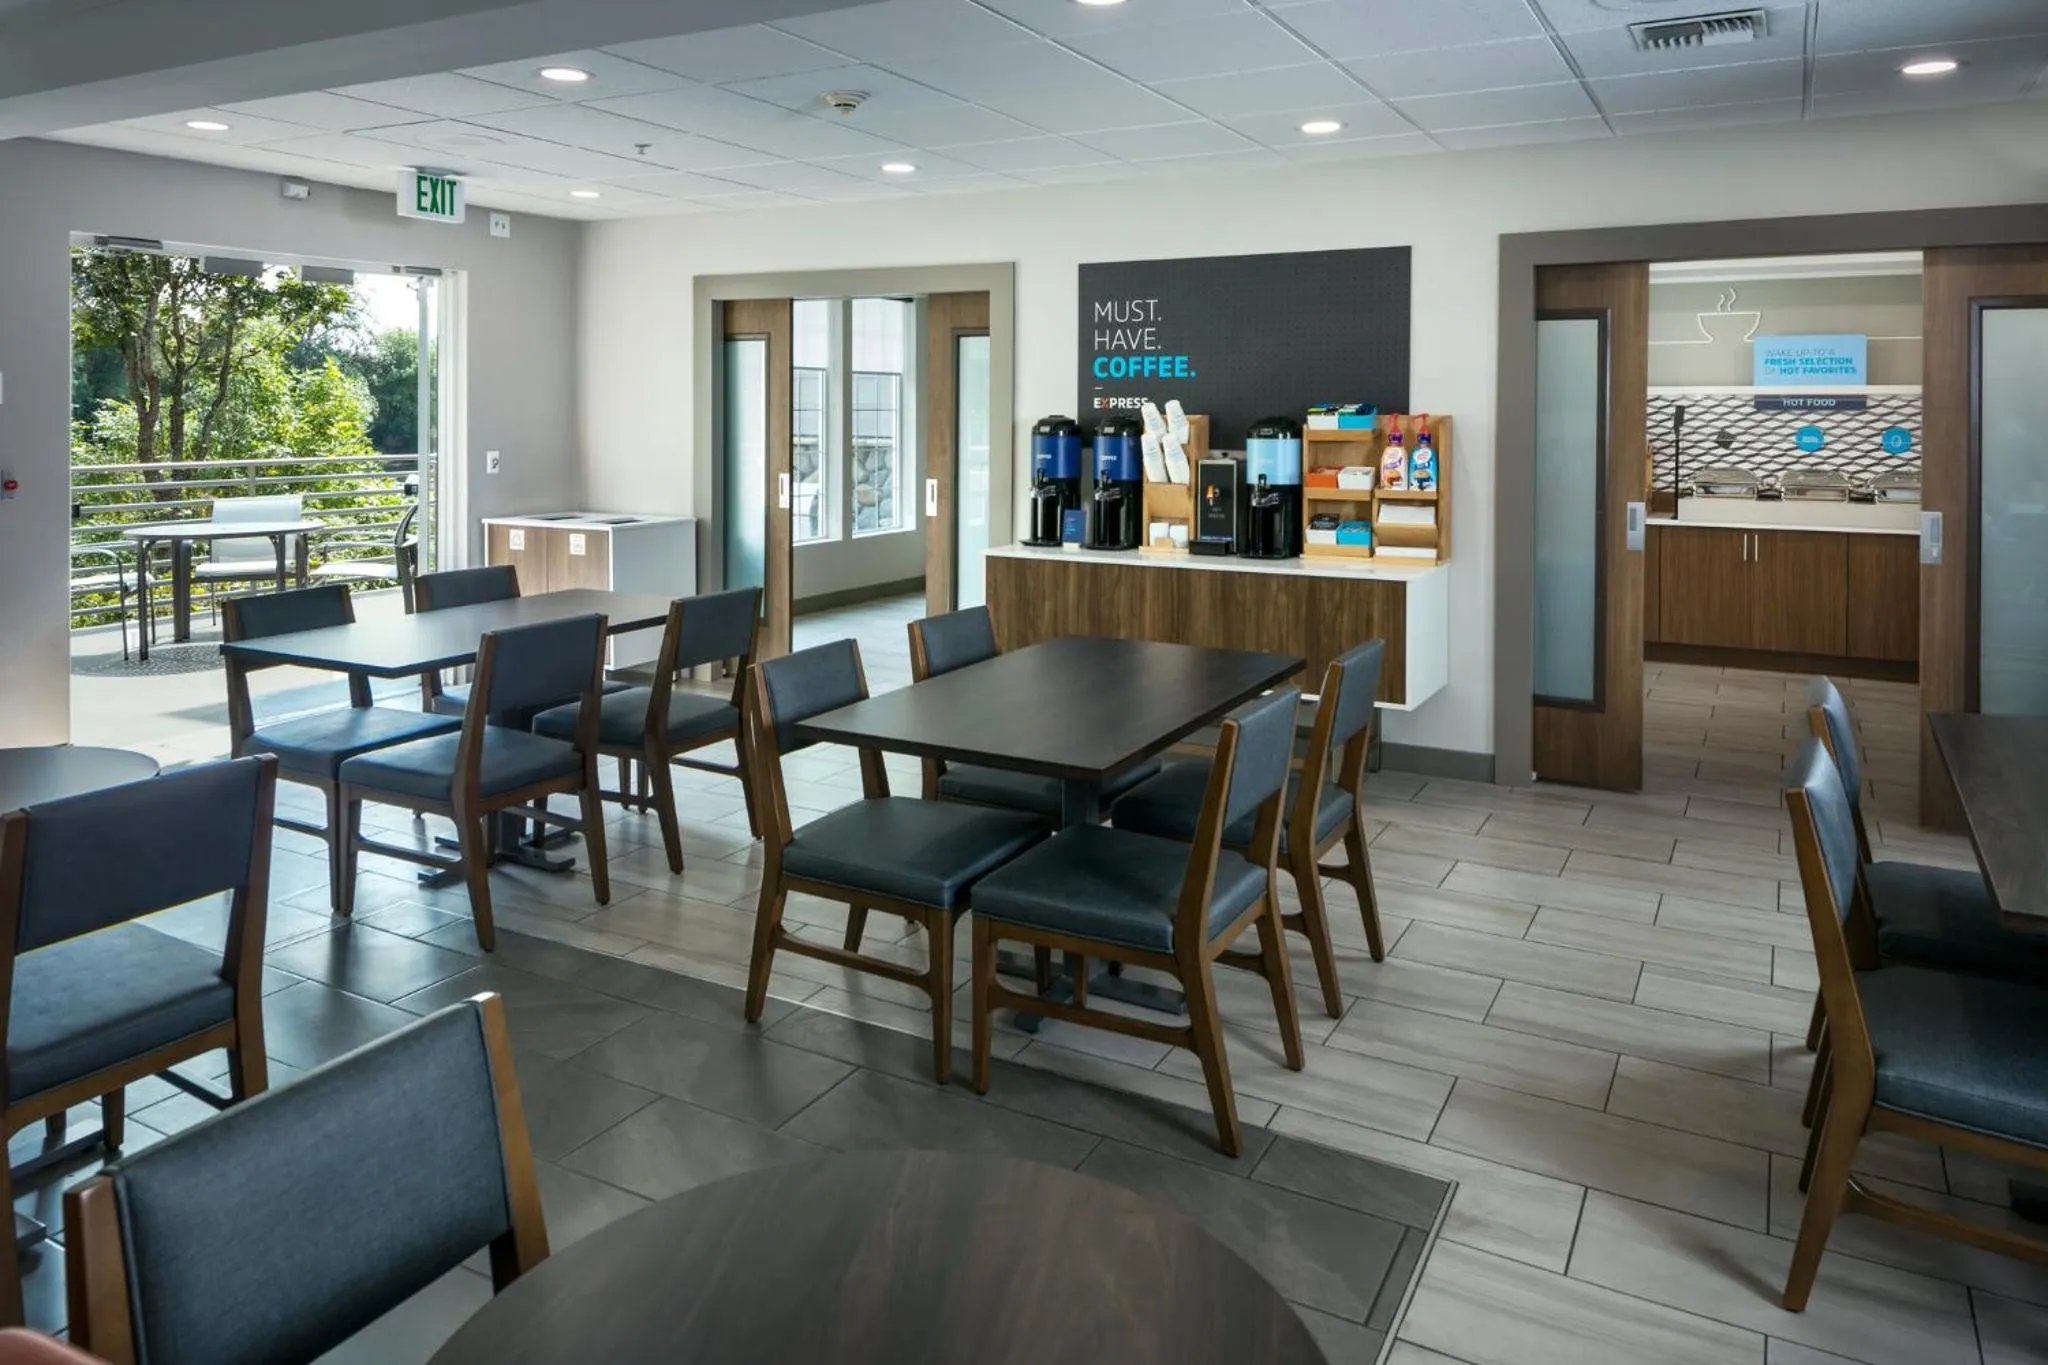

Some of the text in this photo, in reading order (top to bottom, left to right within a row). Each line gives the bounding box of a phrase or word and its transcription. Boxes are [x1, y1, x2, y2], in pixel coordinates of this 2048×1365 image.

[416, 175, 457, 216] EXIT
[1094, 299, 1162, 323] MUST.
[1094, 327, 1162, 351] HAVE.
[1093, 355, 1197, 379] COFFEE.
[1764, 356, 1853, 366] FRESH SELECTION
[1780, 366, 1800, 375] HOT
[1803, 366, 1857, 375] FAVORITES
[1093, 397, 1149, 409] EXPRESS
[1783, 397, 1837, 407] HOT FOOD
